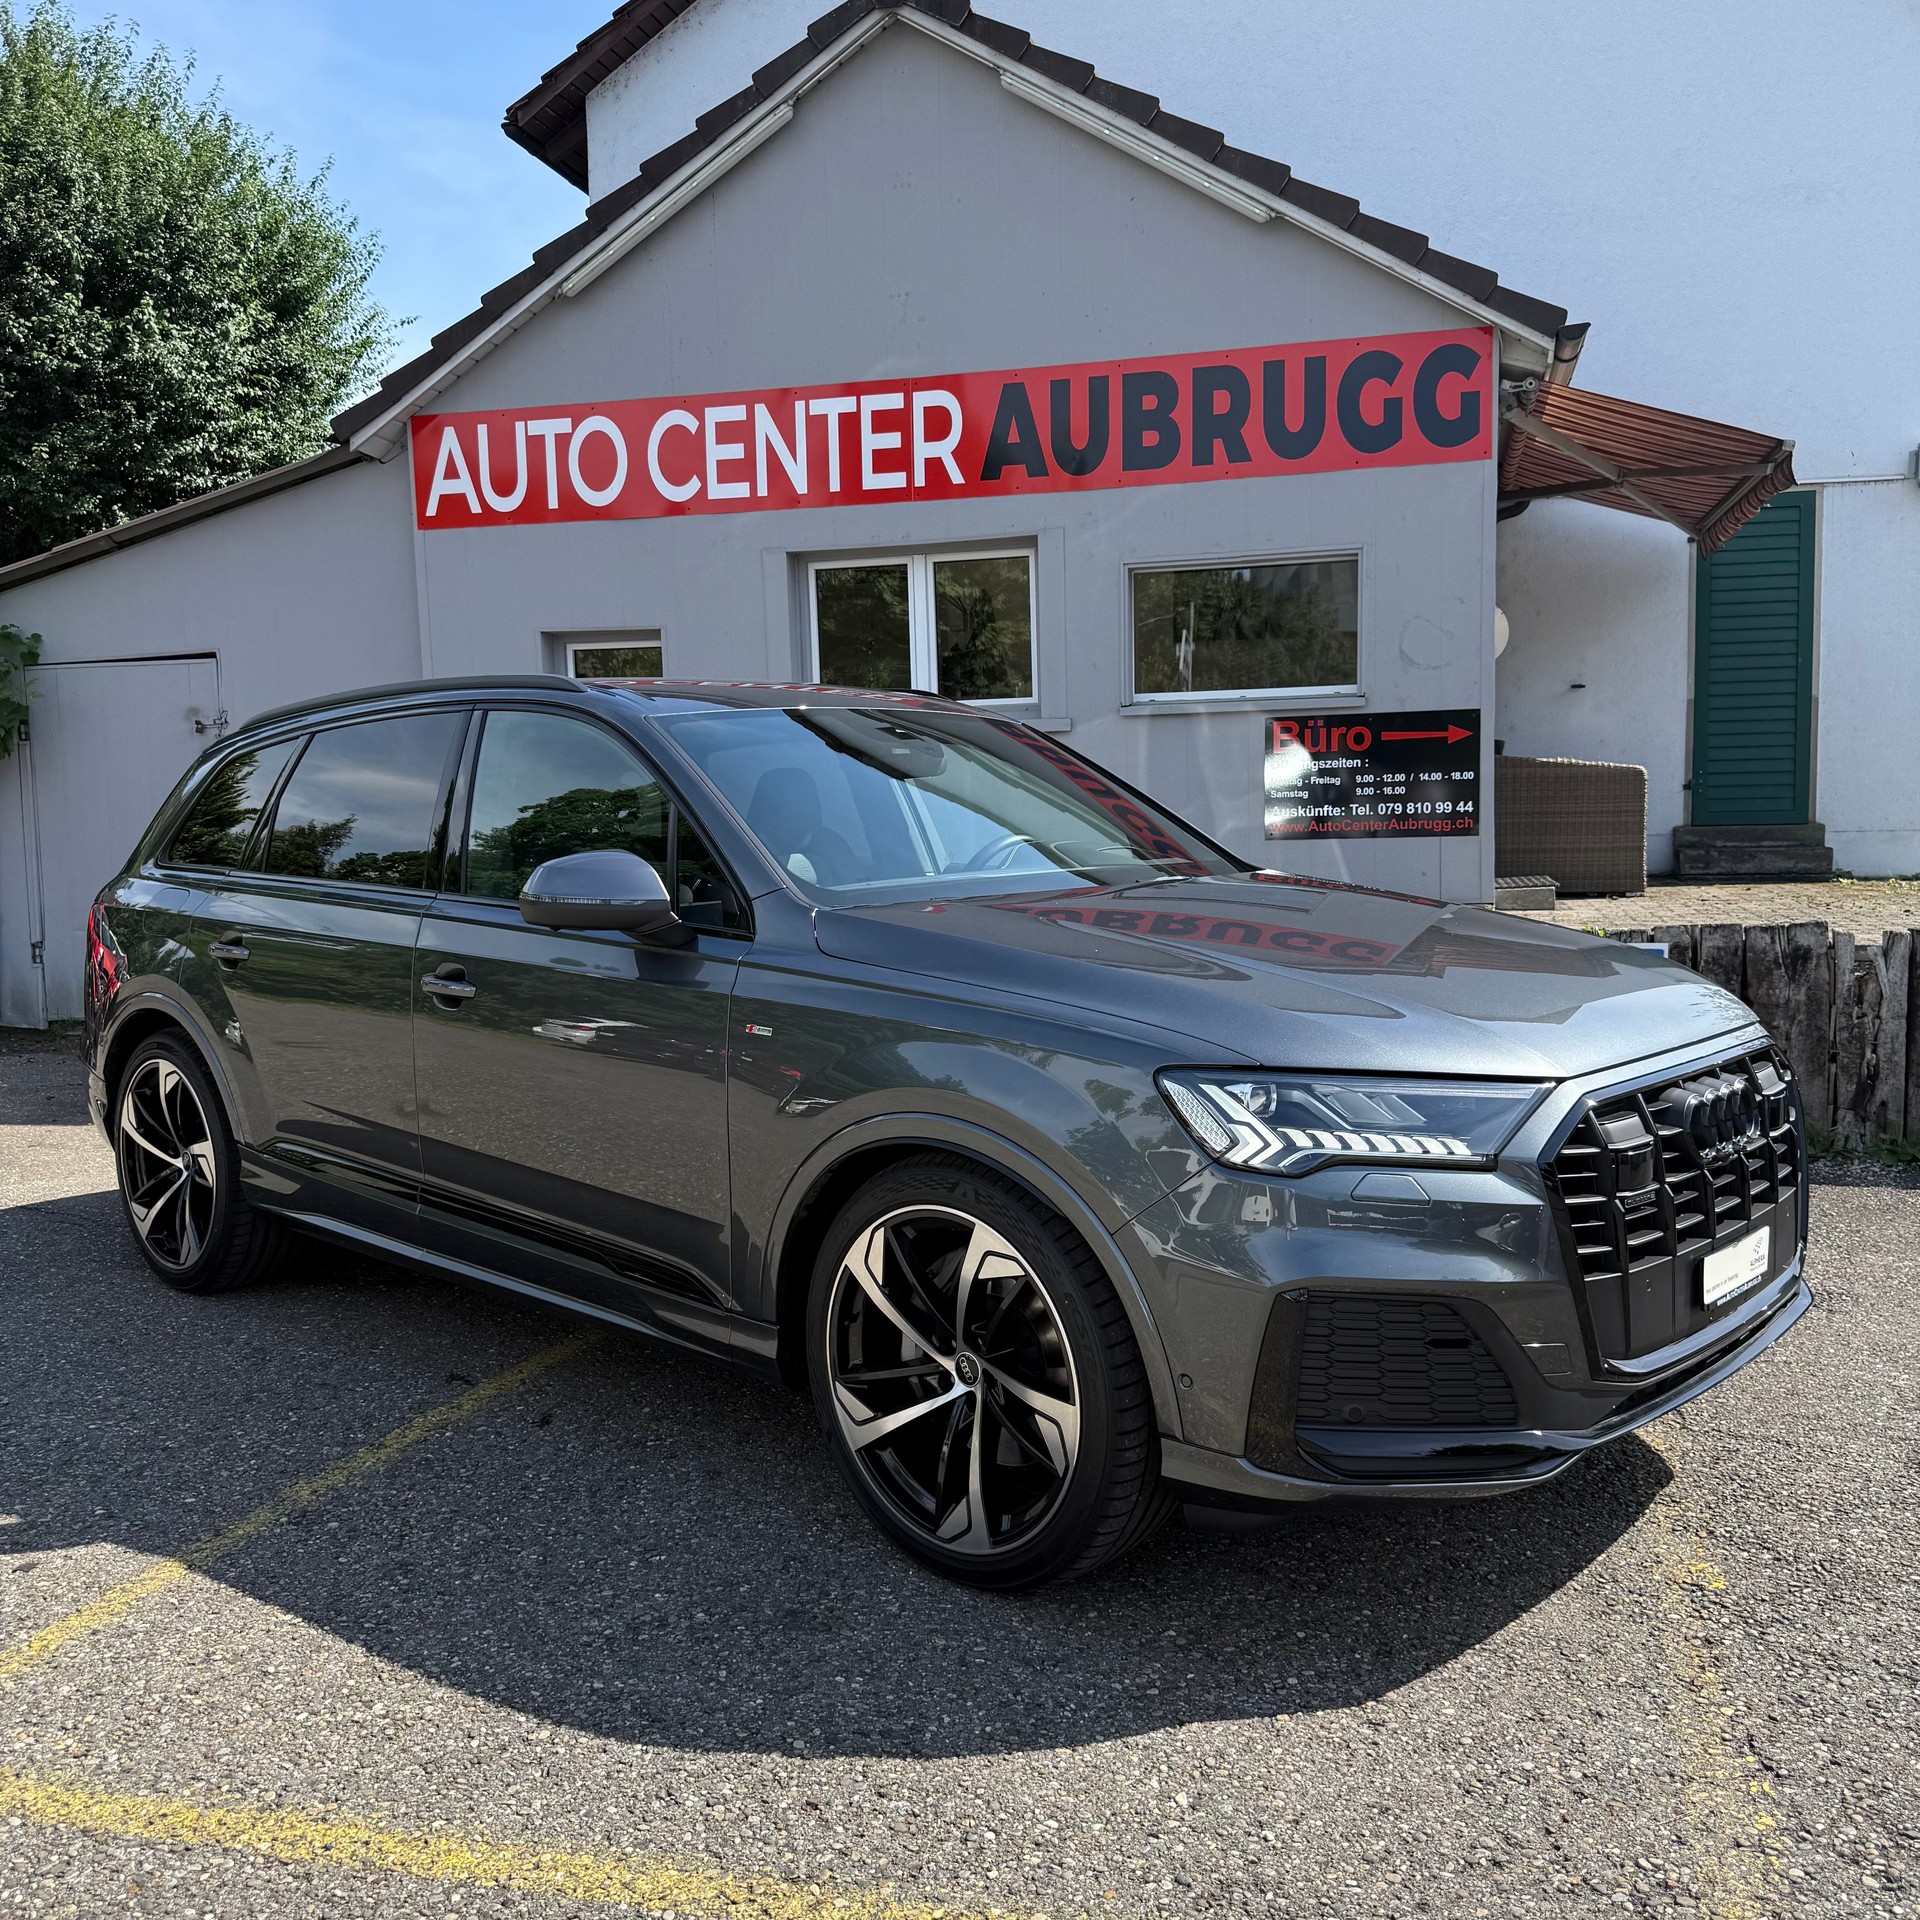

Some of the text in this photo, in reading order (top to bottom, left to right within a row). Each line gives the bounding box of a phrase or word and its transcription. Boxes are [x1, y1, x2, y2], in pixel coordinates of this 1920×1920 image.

[425, 343, 1482, 517] AUTO CENTER AUBRUGG
[1273, 720, 1372, 754] Büro
[1310, 776, 1341, 786] Freitag
[1355, 774, 1374, 783] 9.00
[1382, 773, 1406, 782] 12.00
[1418, 772, 1442, 781] 14.00
[1450, 771, 1474, 780] 18.00
[1270, 790, 1309, 799] Samstag
[1355, 787, 1374, 796] 9.00
[1382, 786, 1406, 795] 16.00
[1271, 800, 1474, 817] Auskünfte: Tel. 079 810 99 44
[1270, 817, 1473, 833] www.AutoCenterAubrugg.ch
